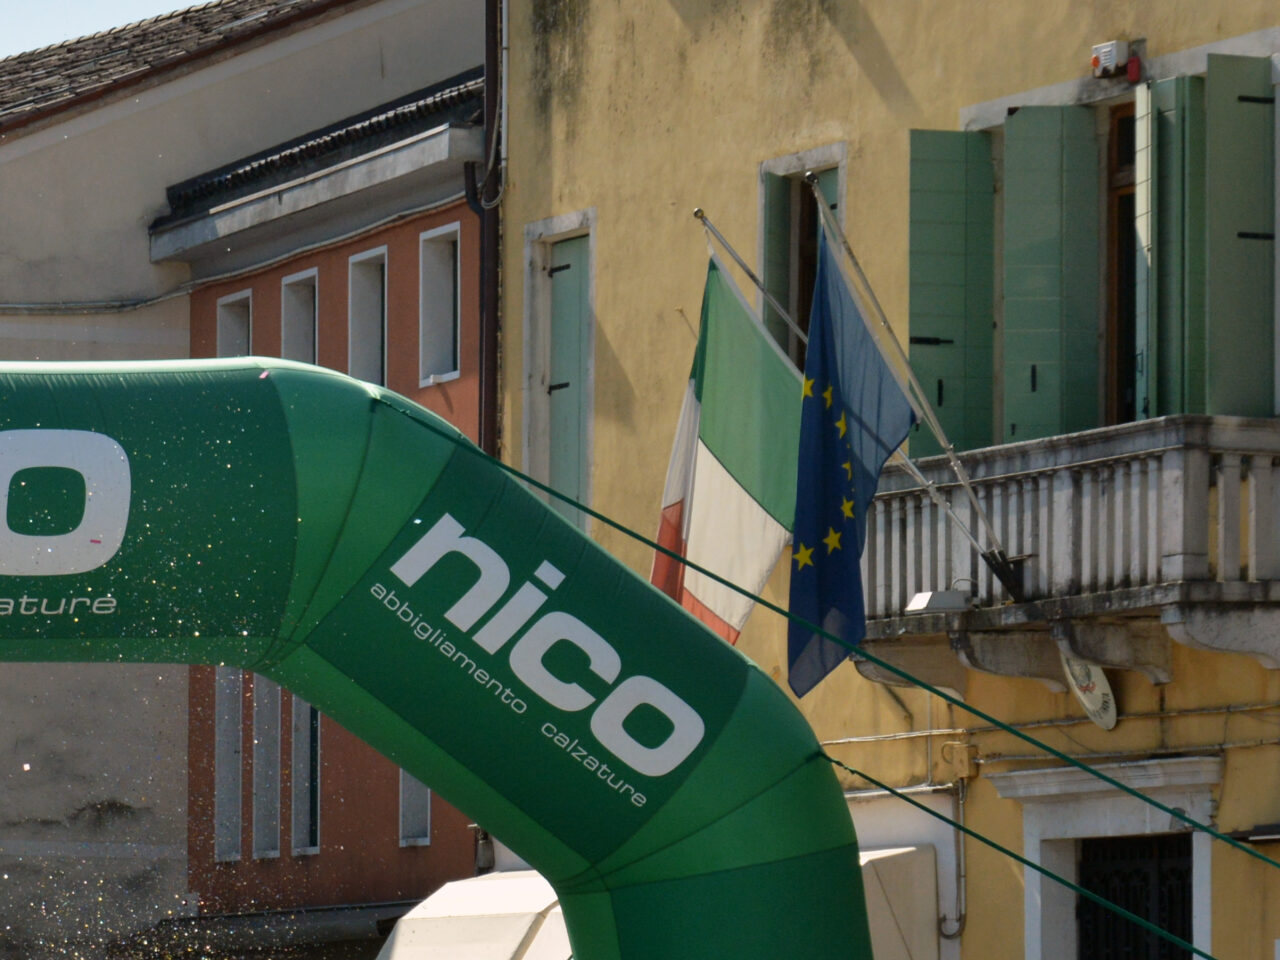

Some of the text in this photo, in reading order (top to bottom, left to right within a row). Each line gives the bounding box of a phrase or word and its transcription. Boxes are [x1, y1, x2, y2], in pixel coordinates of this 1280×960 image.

[370, 582, 647, 807] abbigliamento calzature
[390, 512, 706, 777] nico
